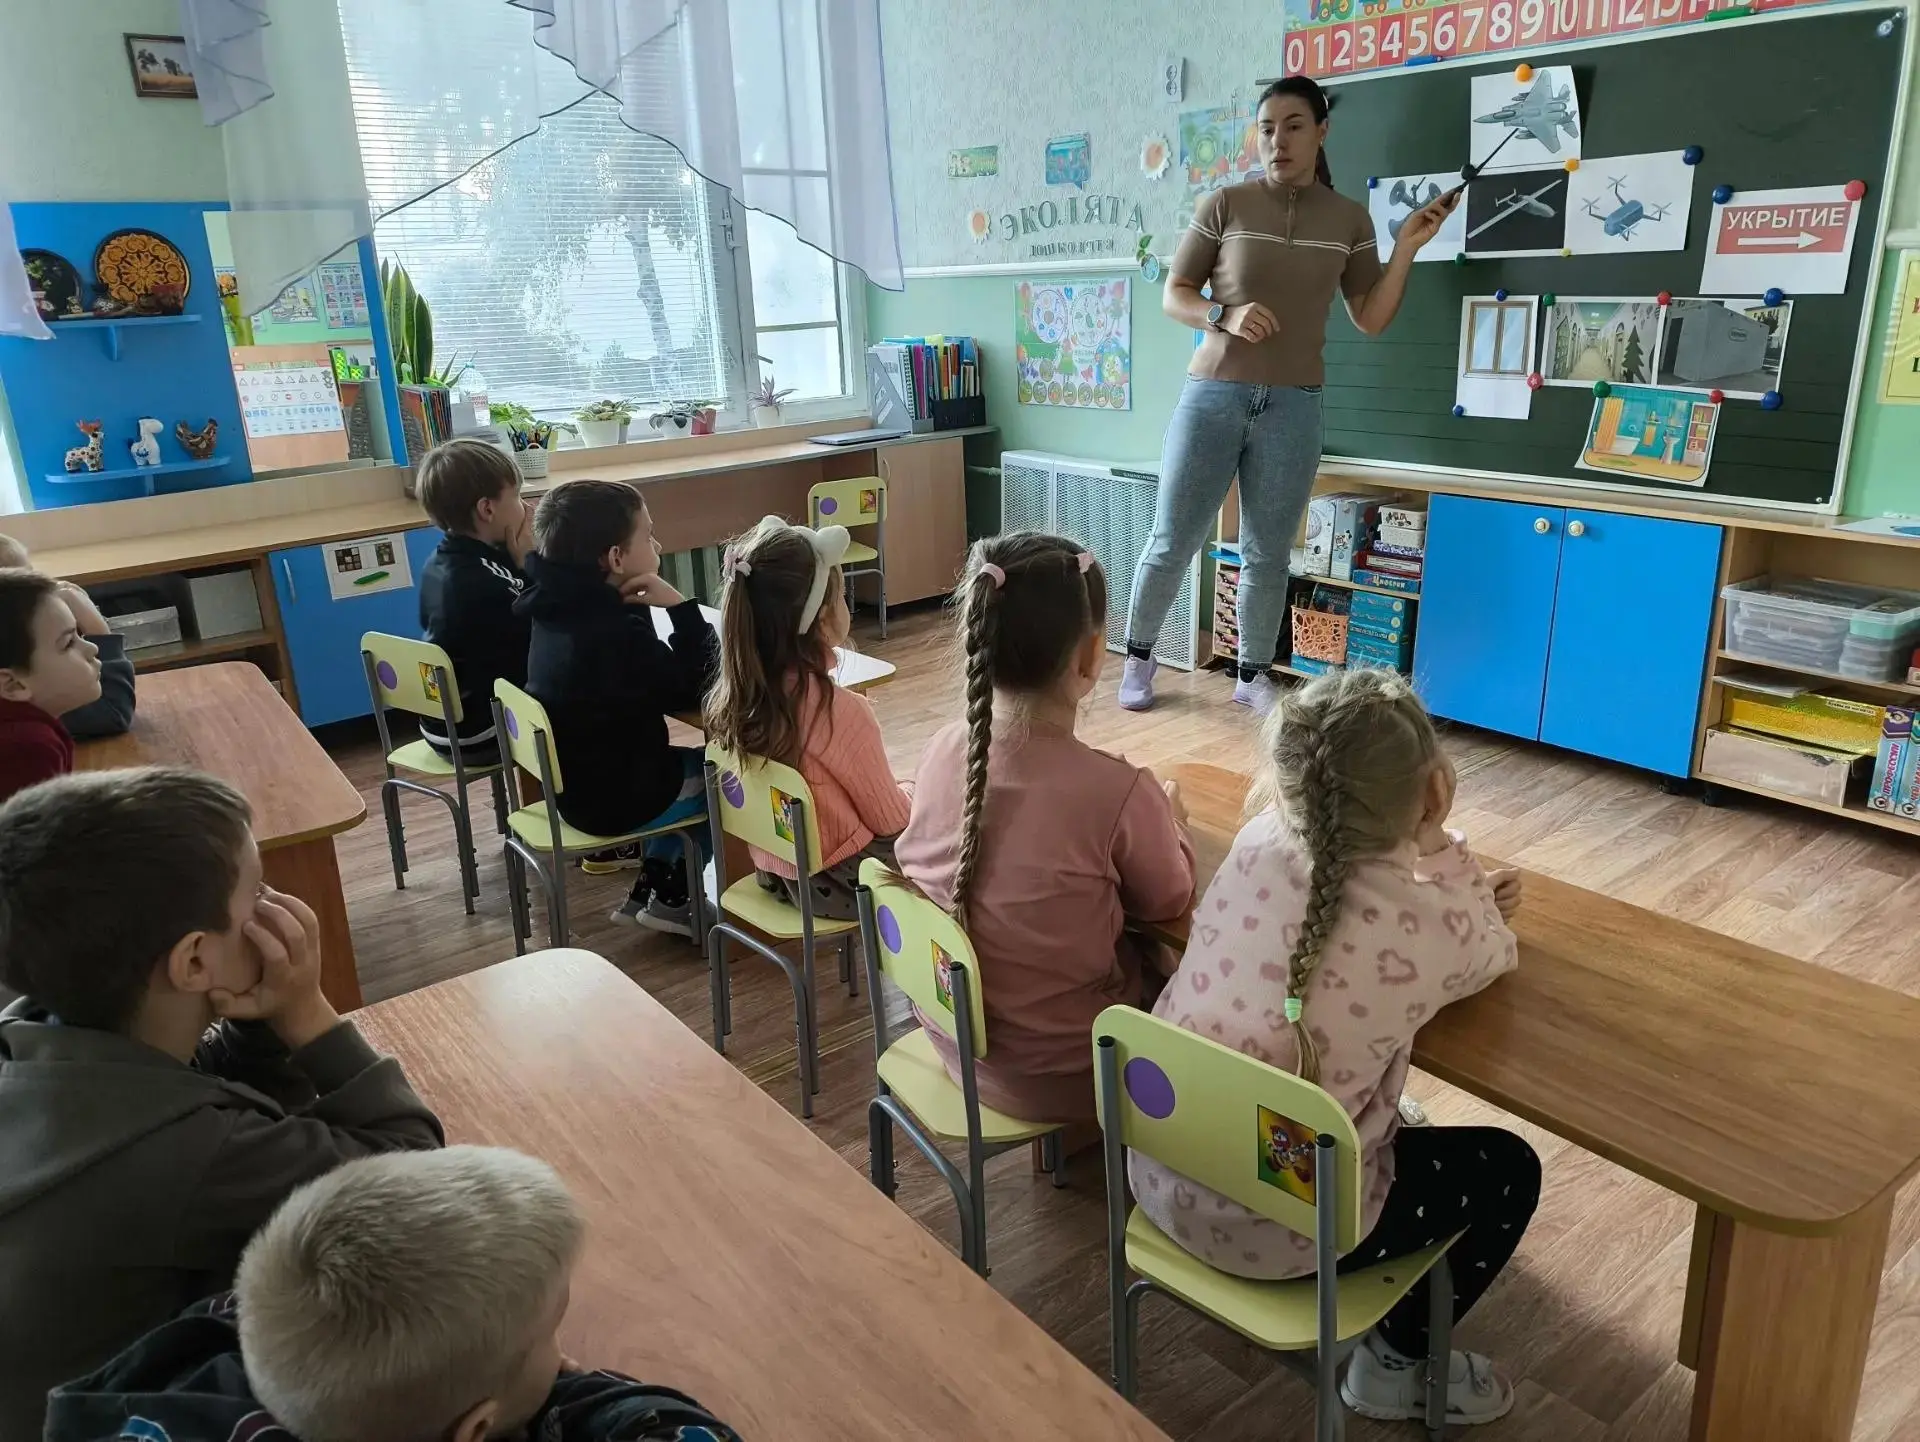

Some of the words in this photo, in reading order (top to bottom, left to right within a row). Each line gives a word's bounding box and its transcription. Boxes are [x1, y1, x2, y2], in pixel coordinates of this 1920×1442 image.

[1286, 38, 1305, 73] 0
[1313, 34, 1325, 70] 1
[1332, 29, 1351, 67] 2
[1357, 24, 1376, 63] 3
[1381, 21, 1403, 58] 4
[1407, 16, 1428, 55] 5
[1433, 11, 1456, 51] 6
[1462, 7, 1484, 48] 7
[1488, 1, 1513, 43] 8
[1520, 0, 1545, 40] 9
[1551, 0, 1579, 35] 10
[1727, 206, 1847, 230] УКРЫТИЕ
[1882, 743, 1901, 796] ПРОФЕССИИ
